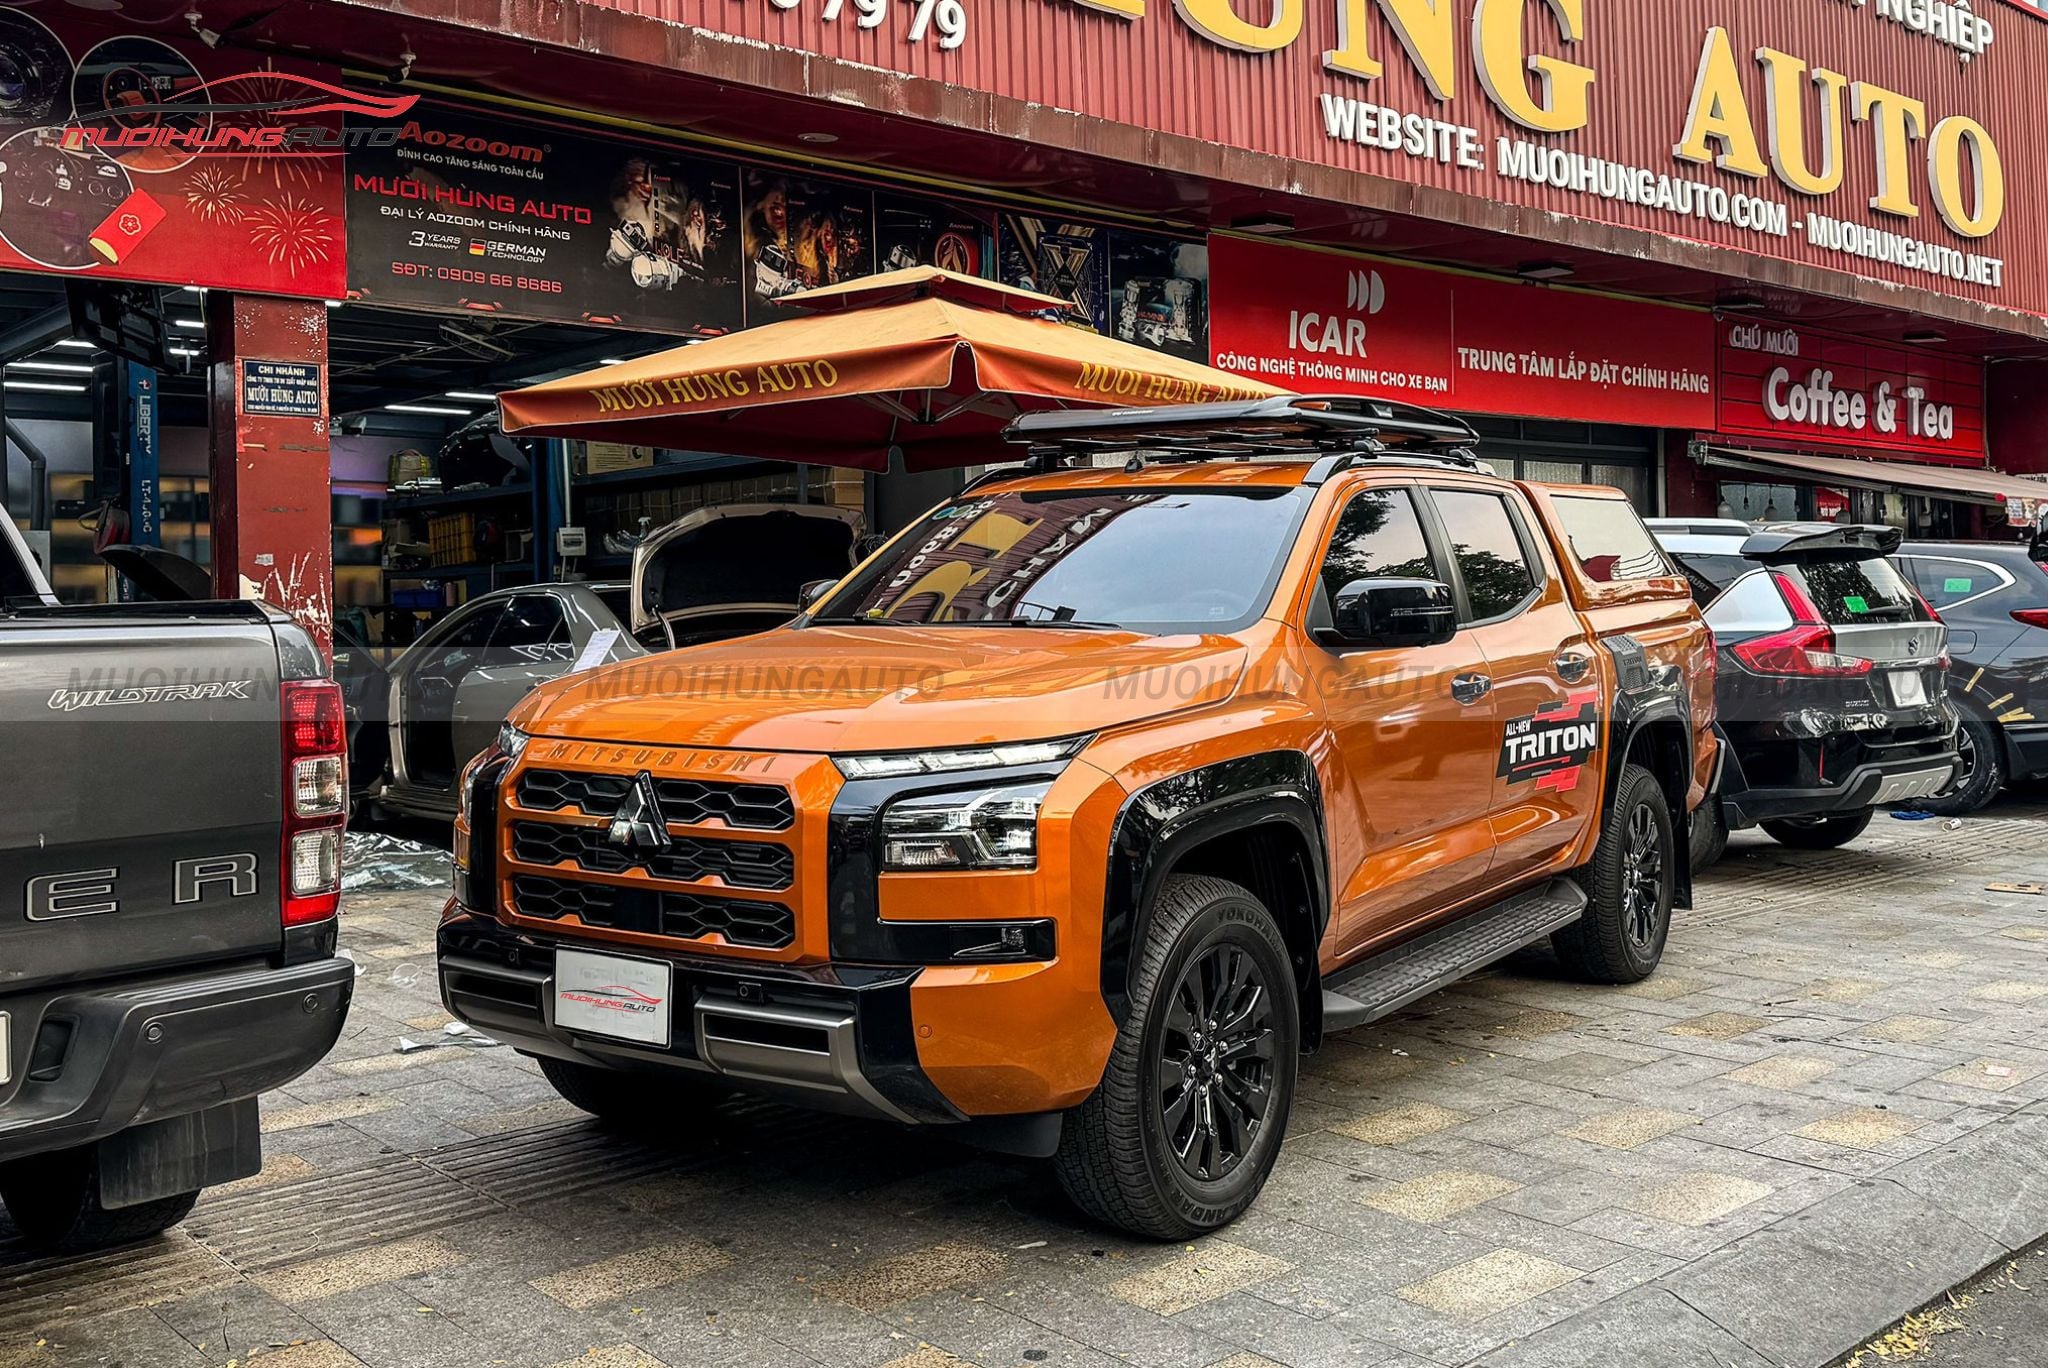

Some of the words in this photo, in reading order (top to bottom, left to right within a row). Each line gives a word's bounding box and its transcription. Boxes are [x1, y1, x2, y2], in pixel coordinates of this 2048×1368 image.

[907, 0, 967, 49] 79
[400, 121, 543, 163] Aozoom
[1672, 25, 2005, 239] AUTO
[423, 153, 443, 164] CAO
[472, 160, 498, 173] SÁNG
[499, 163, 524, 177] TOÀN
[354, 174, 427, 199] MƯỜI
[435, 183, 515, 213] HÙNG
[521, 200, 592, 224] AUTO
[1320, 93, 1484, 170] WEBSITE:
[1496, 136, 1787, 236] MUOIHUNGAUTO.COM
[1807, 212, 2003, 287] MUOIHUNGAUTO.NET
[380, 205, 404, 219] ĐẠI
[407, 207, 424, 220] LÝ
[426, 213, 485, 228] AOZOOM
[488, 218, 531, 235] CHÍNH
[408, 231, 425, 247] 3
[427, 233, 461, 245] YEARS
[487, 241, 546, 257] GERMAN
[487, 250, 545, 264] TECHNOLOGY
[392, 262, 433, 278] SĐT:
[437, 267, 485, 284] 0909
[489, 273, 512, 287] 66
[517, 277, 562, 294] 8686
[1288, 310, 1367, 358] ICAR
[1730, 324, 1762, 351] CHÚ
[258, 366, 273, 374] CHI
[662, 369, 749, 404] HÙNG
[757, 359, 838, 393] AUTO
[1217, 351, 1257, 371] CÔNG
[1259, 357, 1296, 379] NGHỆ
[1298, 360, 1343, 380] THÔNG
[1345, 367, 1377, 385] MINH
[1380, 370, 1406, 387] CHO
[1408, 374, 1422, 389] XE
[1425, 375, 1447, 395] BẠN
[1458, 347, 1516, 374] TRUNG
[1519, 351, 1554, 378] TÂM
[1558, 351, 1587, 381] LẮP
[1590, 359, 1618, 390] ĐẶT
[1621, 363, 1667, 390] CHÍNH
[1671, 367, 1709, 394] HÃNG
[271, 386, 294, 403] HÙNG
[295, 390, 317, 404] AUTO
[1763, 366, 1866, 430] Coffee
[1872, 381, 1897, 433] &
[1903, 386, 1953, 440] Tea
[47, 680, 252, 711] WILDTRAK
[1506, 718, 1531, 736] ALL-NEW
[547, 742, 778, 774] MITSUBISHI
[1505, 722, 1596, 765] TRITON
[560, 992, 656, 1013] MUOIHUNGAUTO
